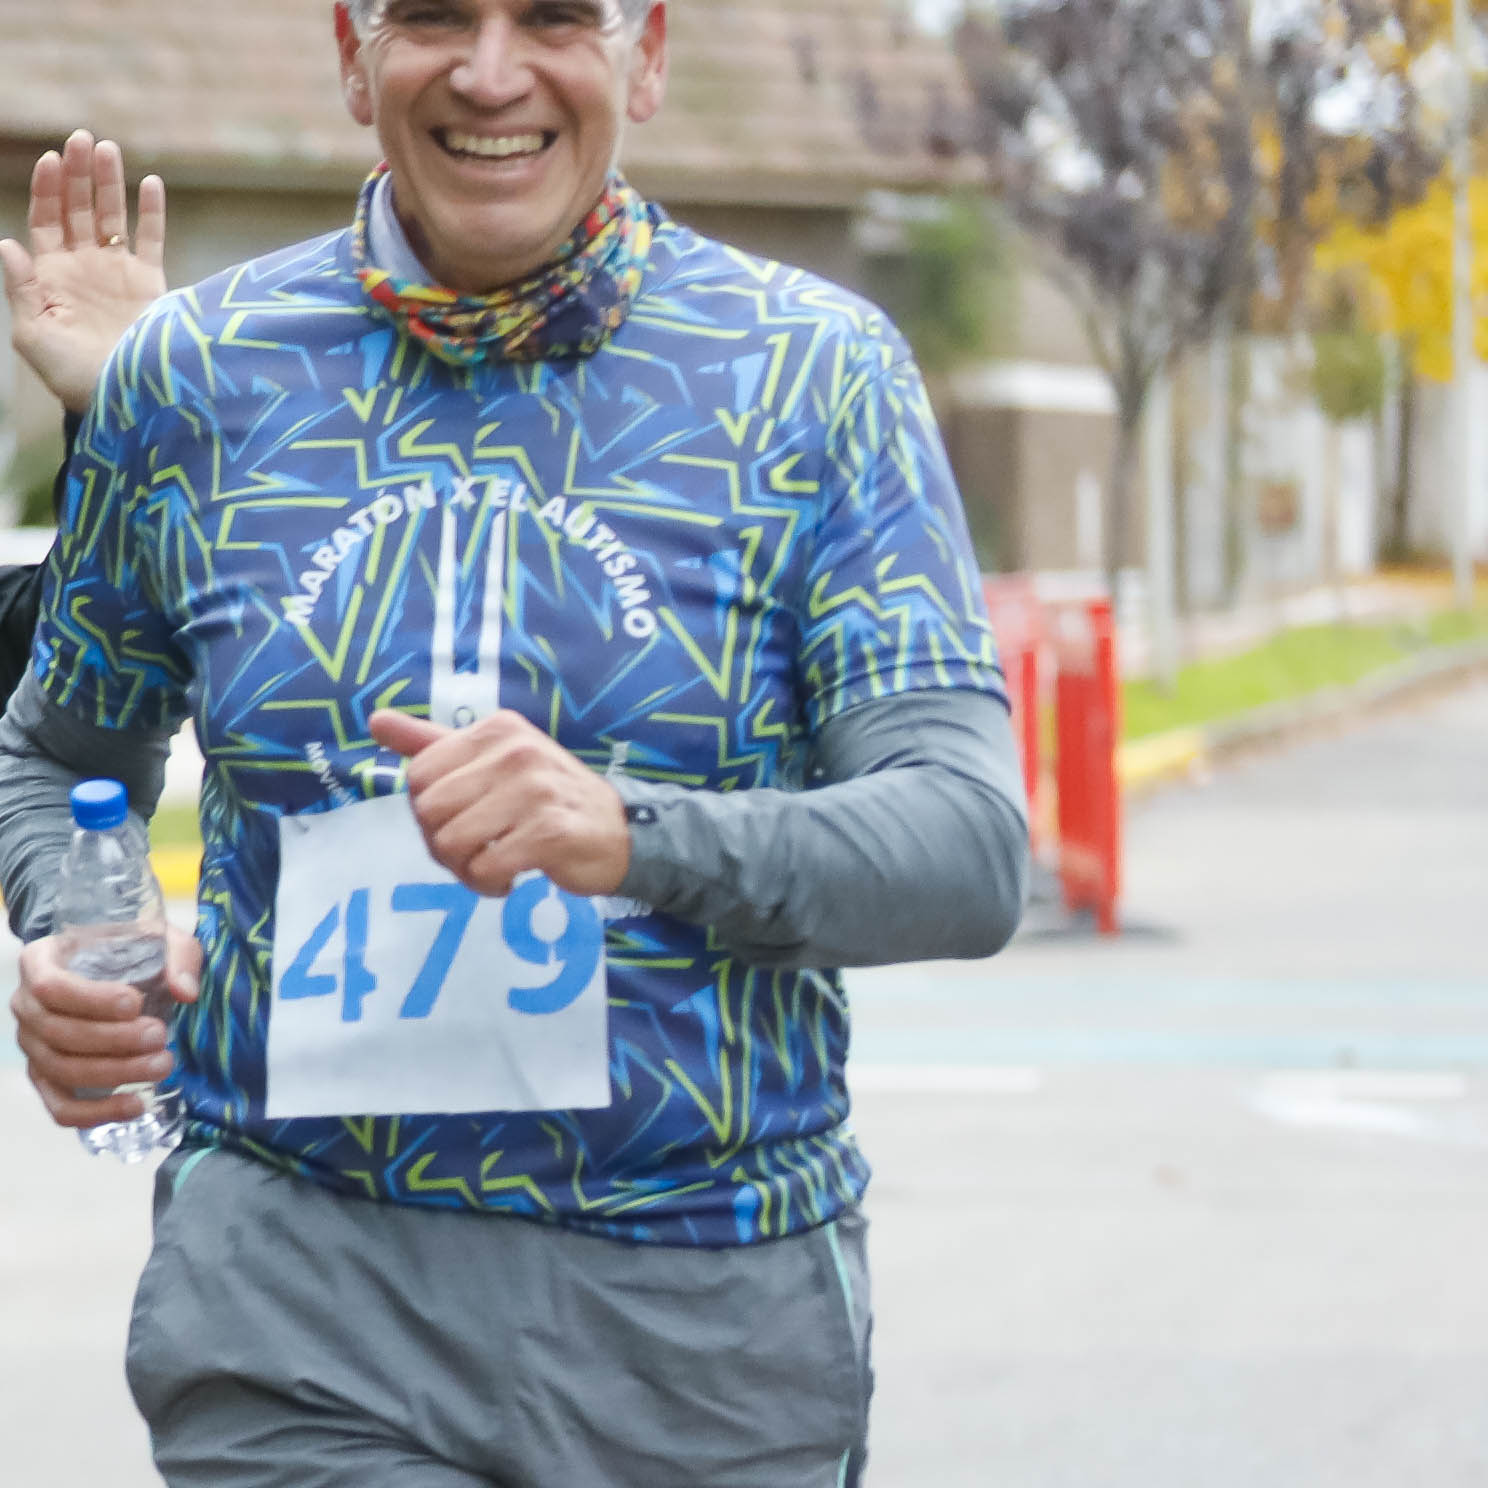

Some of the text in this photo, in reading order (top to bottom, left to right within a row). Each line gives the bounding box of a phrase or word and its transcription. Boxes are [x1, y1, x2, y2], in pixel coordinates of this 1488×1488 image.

[284, 475, 659, 639] MARATÓN X EL AUTISMO
[278, 871, 602, 1024] 479
